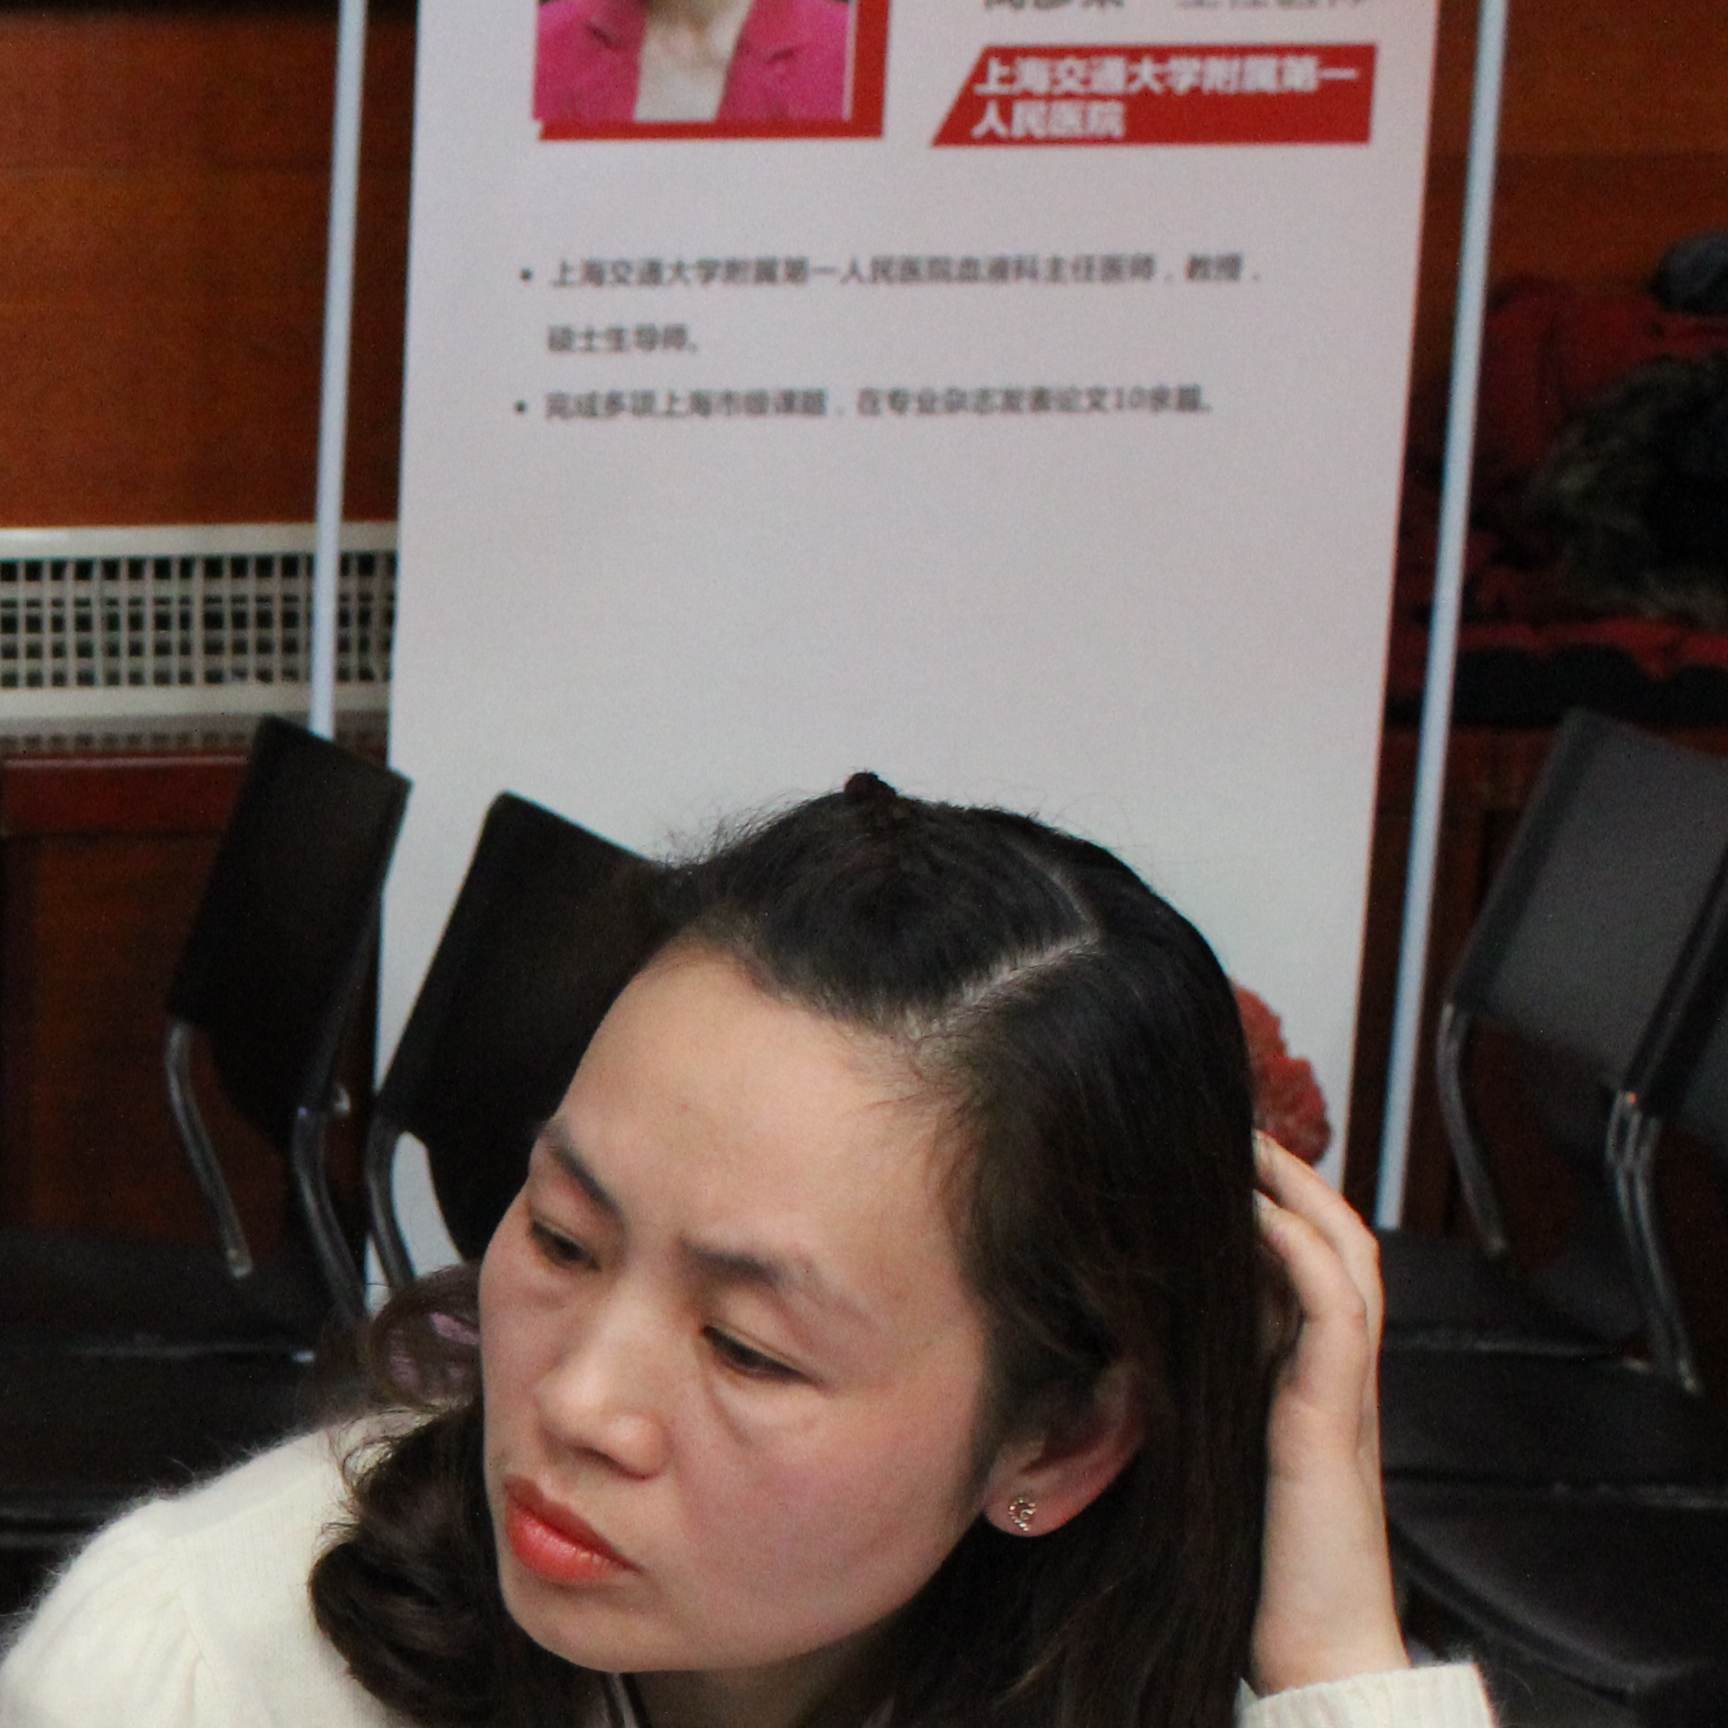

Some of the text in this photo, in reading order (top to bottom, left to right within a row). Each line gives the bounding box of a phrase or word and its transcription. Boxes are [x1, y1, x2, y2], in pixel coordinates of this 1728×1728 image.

[974, 55, 1358, 95] 上海交通大学附属第一
[972, 100, 1126, 139] 人民医院
